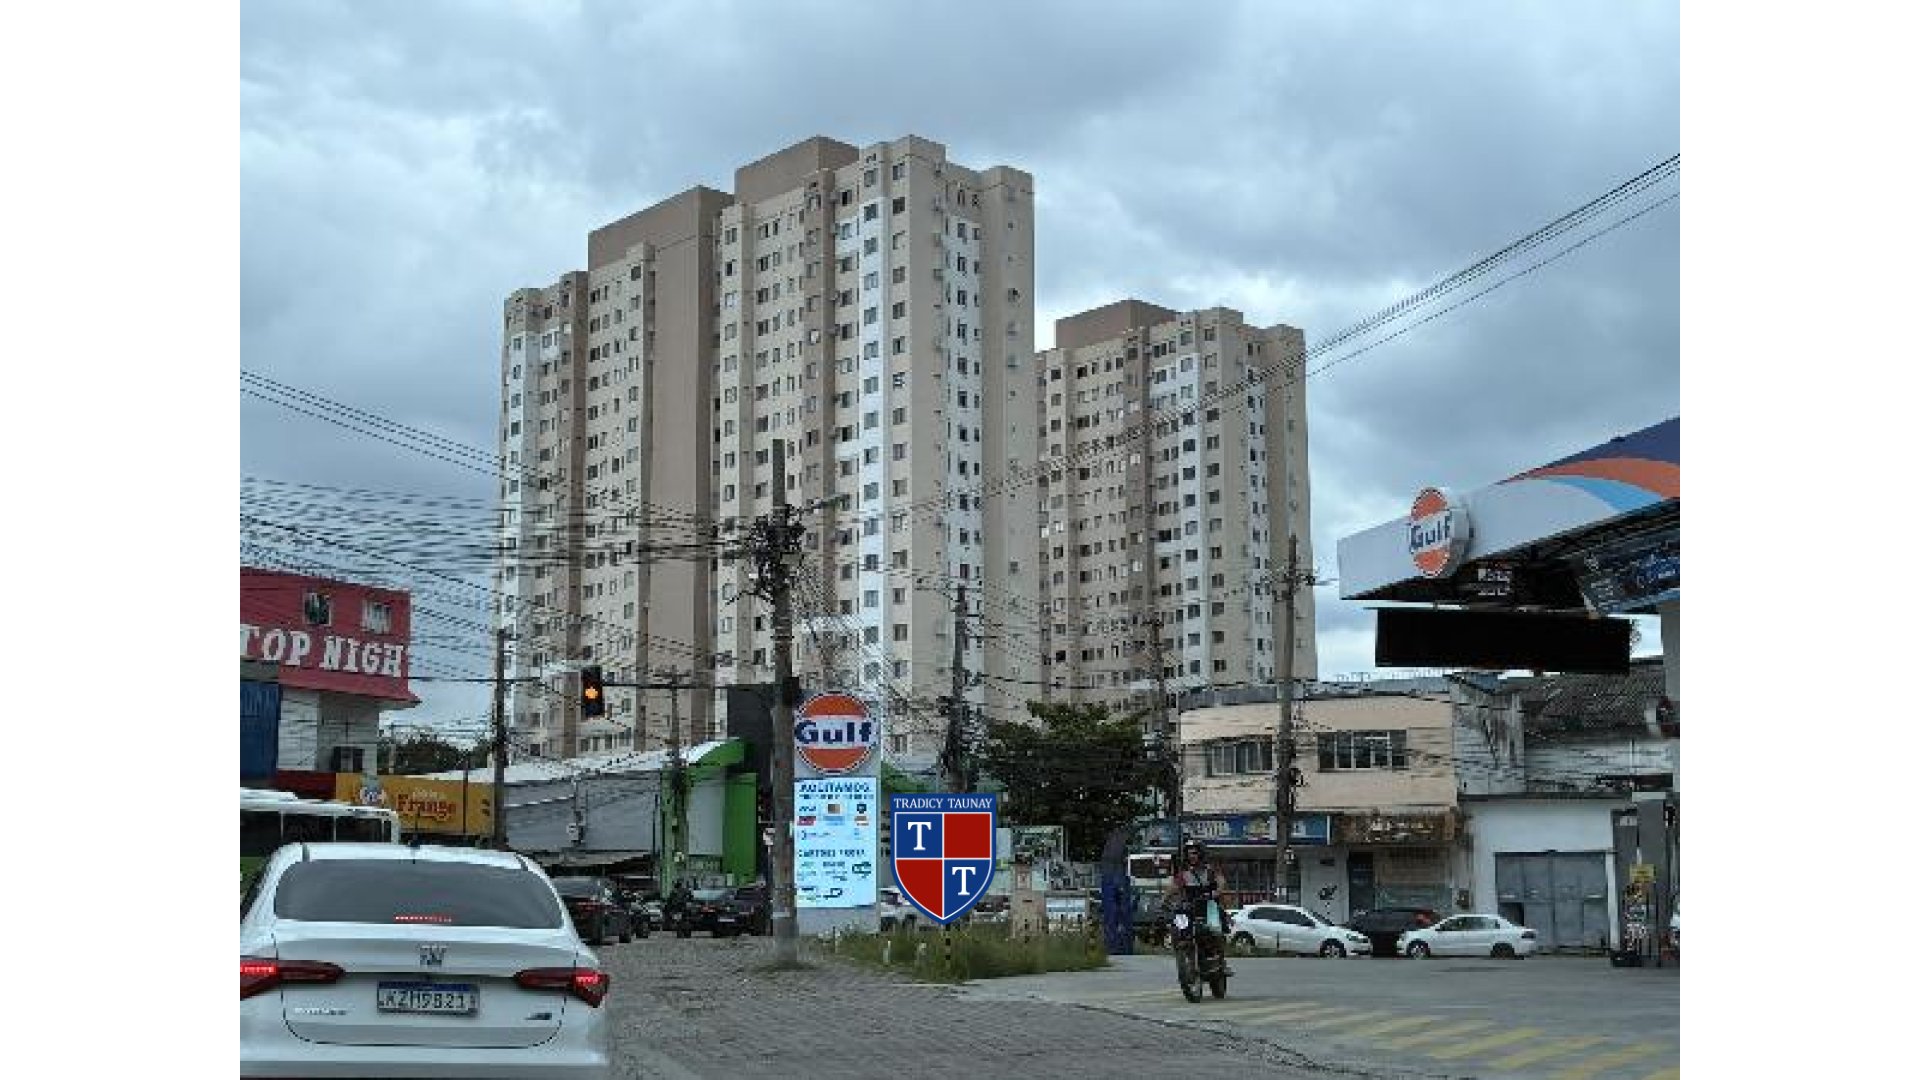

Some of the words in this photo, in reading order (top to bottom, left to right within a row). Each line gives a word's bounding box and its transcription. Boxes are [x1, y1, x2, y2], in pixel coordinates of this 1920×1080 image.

[1410, 515, 1450, 548] Gulf
[240, 624, 310, 666] TOP
[794, 721, 872, 744] Gulf
